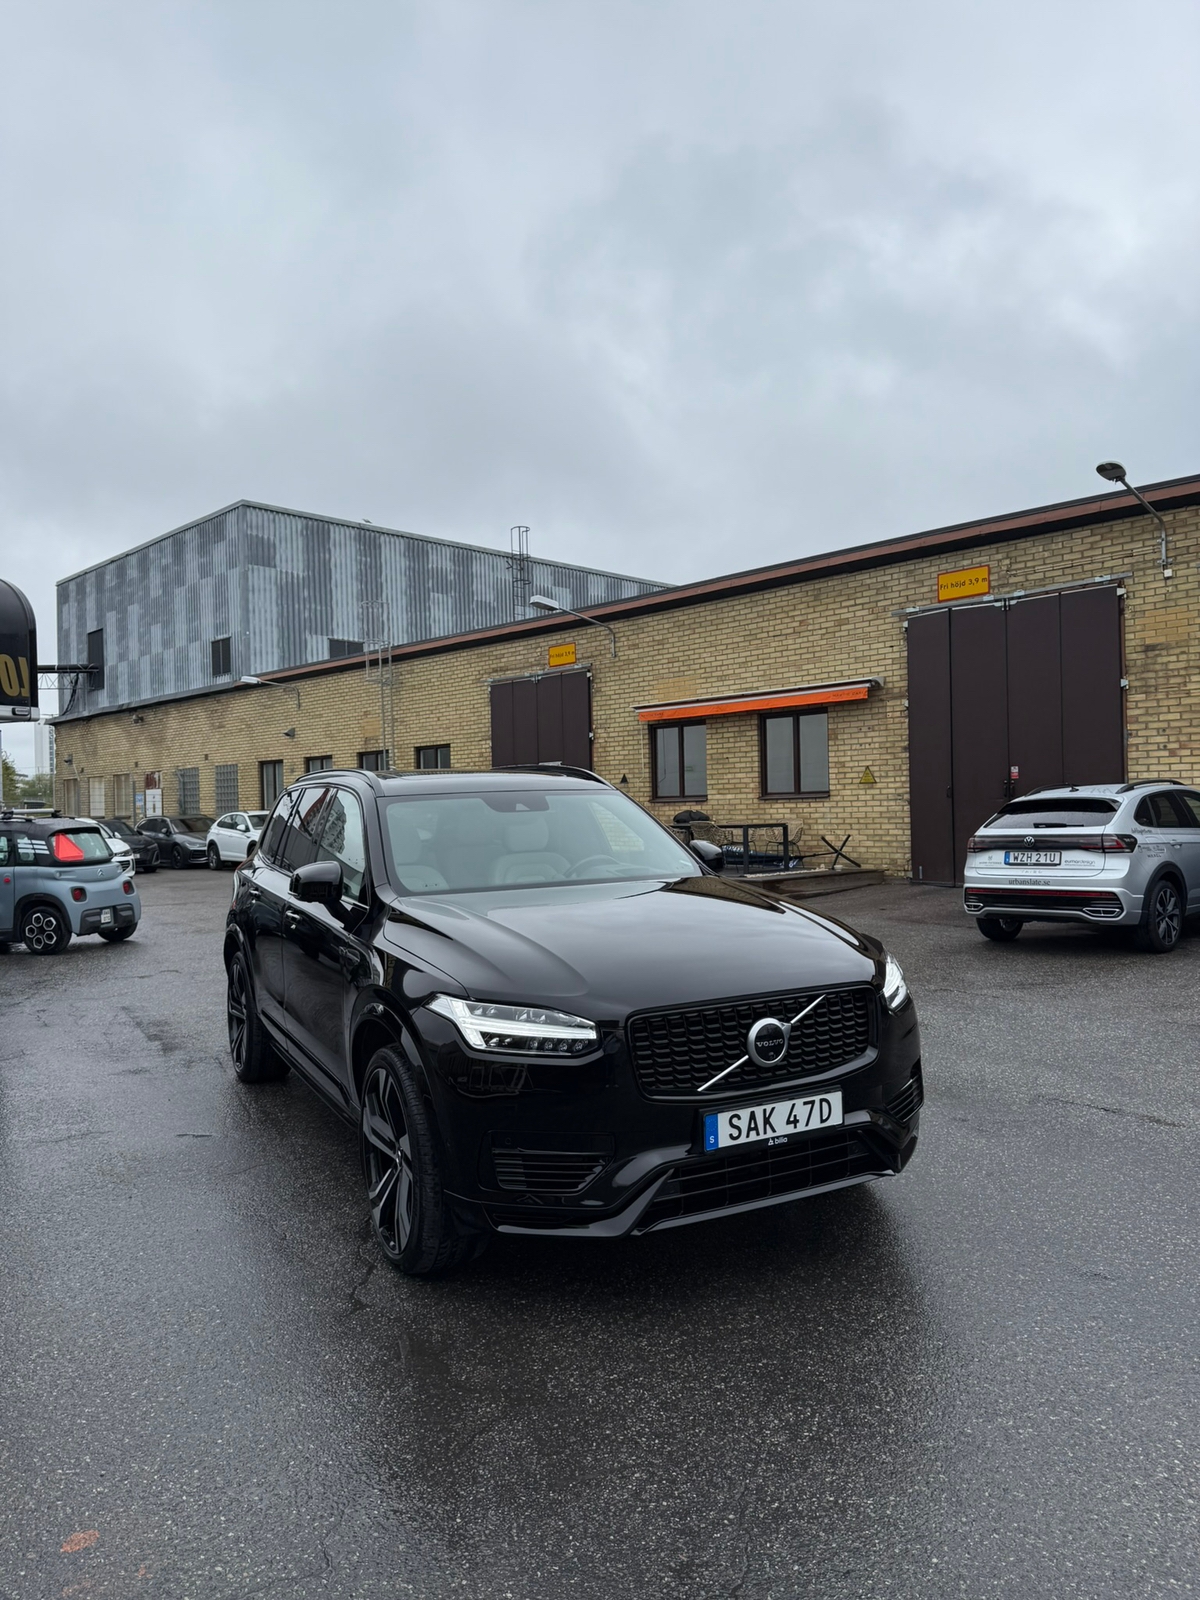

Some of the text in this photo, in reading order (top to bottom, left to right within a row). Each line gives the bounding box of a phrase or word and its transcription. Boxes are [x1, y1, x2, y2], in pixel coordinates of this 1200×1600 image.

[950, 580, 966, 588] höjd
[968, 577, 979, 585] 3,9
[1013, 852, 1032, 862] WZH
[1035, 852, 1056, 862] 21U
[1008, 878, 1051, 886] urbanslate.se
[756, 1038, 784, 1047] VOLVO
[728, 1097, 832, 1141] SAK 47D
[709, 1135, 715, 1144] S
[774, 1136, 788, 1145] bilia
